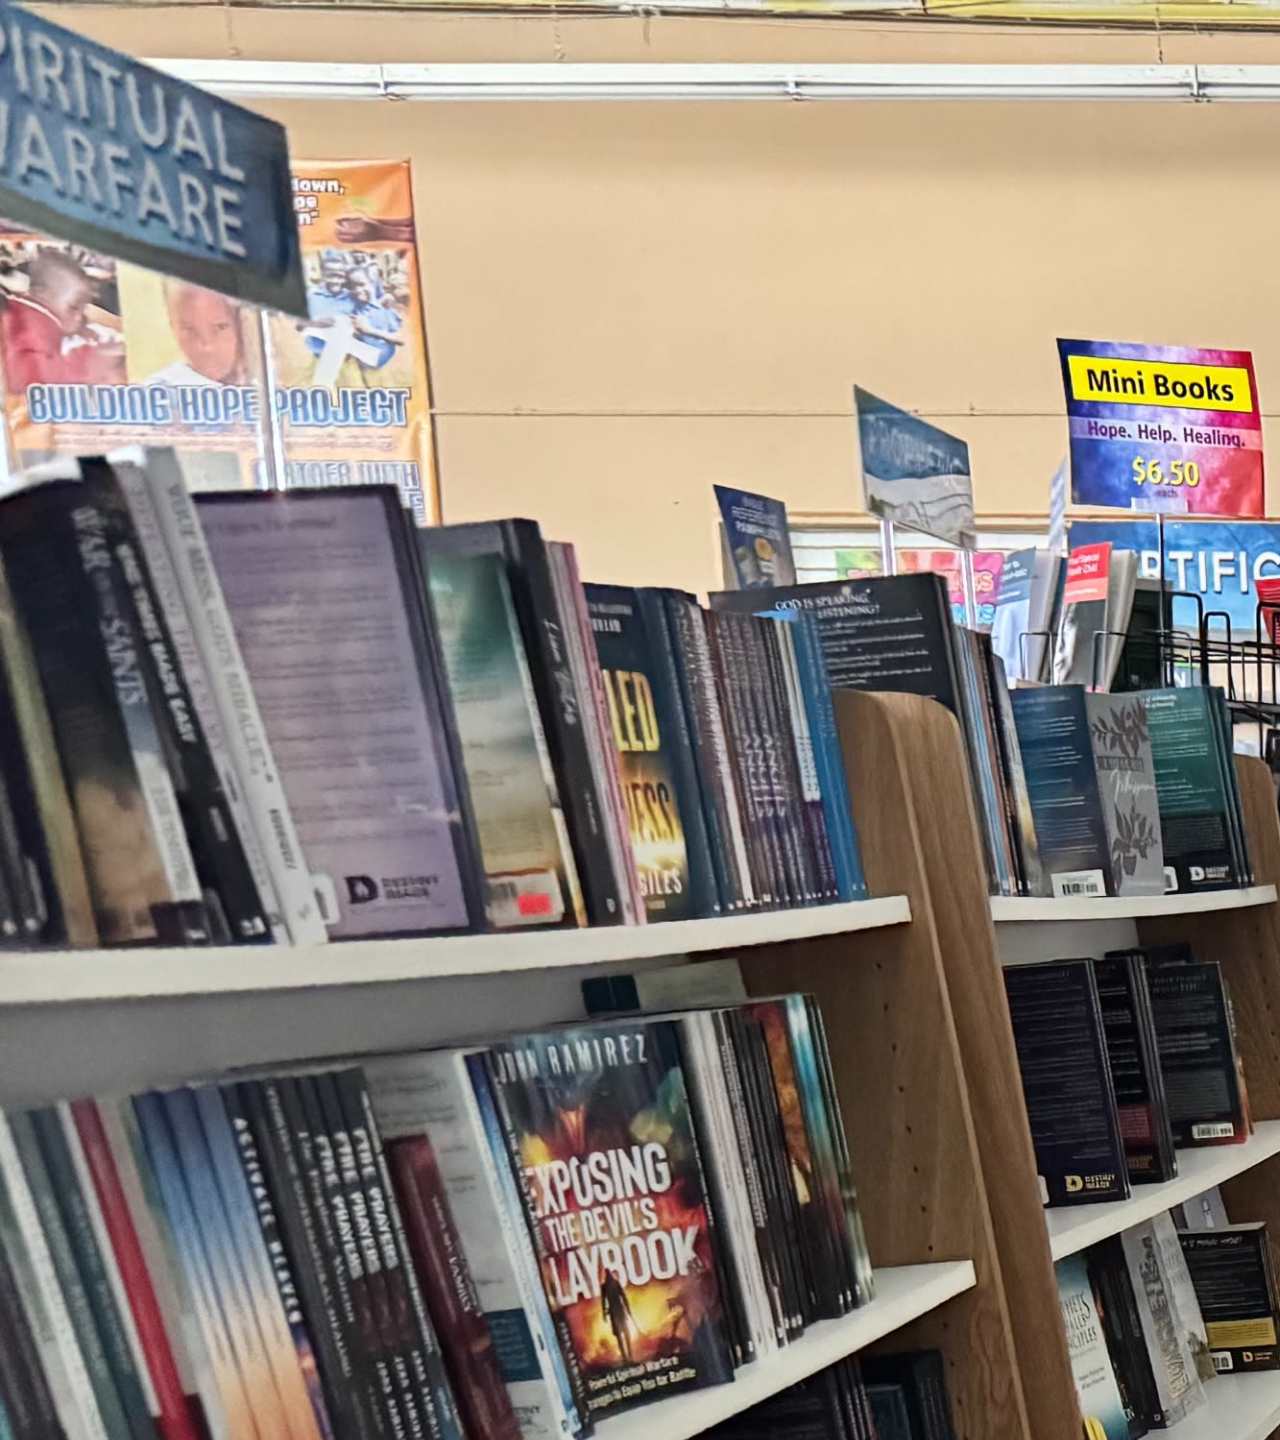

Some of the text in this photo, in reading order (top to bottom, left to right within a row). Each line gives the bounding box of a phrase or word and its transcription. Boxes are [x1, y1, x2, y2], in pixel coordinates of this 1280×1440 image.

[0, 22, 246, 182] IRITUAL
[0, 103, 247, 257] ARFARE
[27, 384, 411, 428] BUILDING HOPE PROJECT
[1086, 367, 1235, 403] Mini Books
[1087, 419, 1247, 450] Hope. Help. Healing.
[1131, 455, 1200, 488] $6.50
[775, 599, 802, 613] GOD
[548, 1033, 649, 1077] RAMIREZ
[546, 1199, 659, 1253] THE DEVIL'S
[548, 1225, 702, 1307] LAYBOOK
